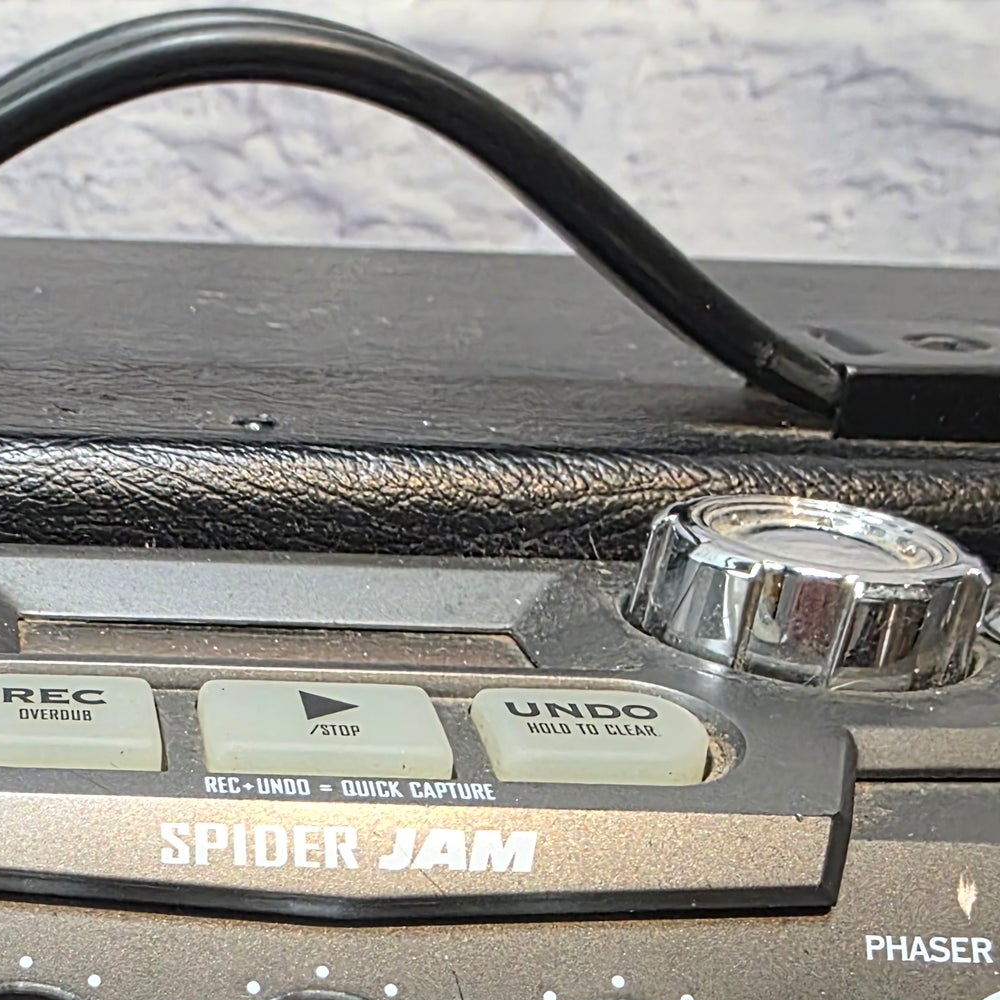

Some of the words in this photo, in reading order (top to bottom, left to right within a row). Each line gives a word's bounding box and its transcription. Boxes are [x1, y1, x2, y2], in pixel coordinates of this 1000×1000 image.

[2, 687, 107, 705] REC
[19, 708, 93, 722] OVERDUB
[504, 701, 659, 721] UNDO
[527, 722, 572, 736] HOLD
[577, 723, 600, 737] TO
[341, 780, 403, 799] QUICK
[409, 781, 497, 801] CAPTURE
[160, 822, 359, 870] SPIDER
[378, 828, 538, 873] JAM
[865, 934, 993, 964] PHASER
